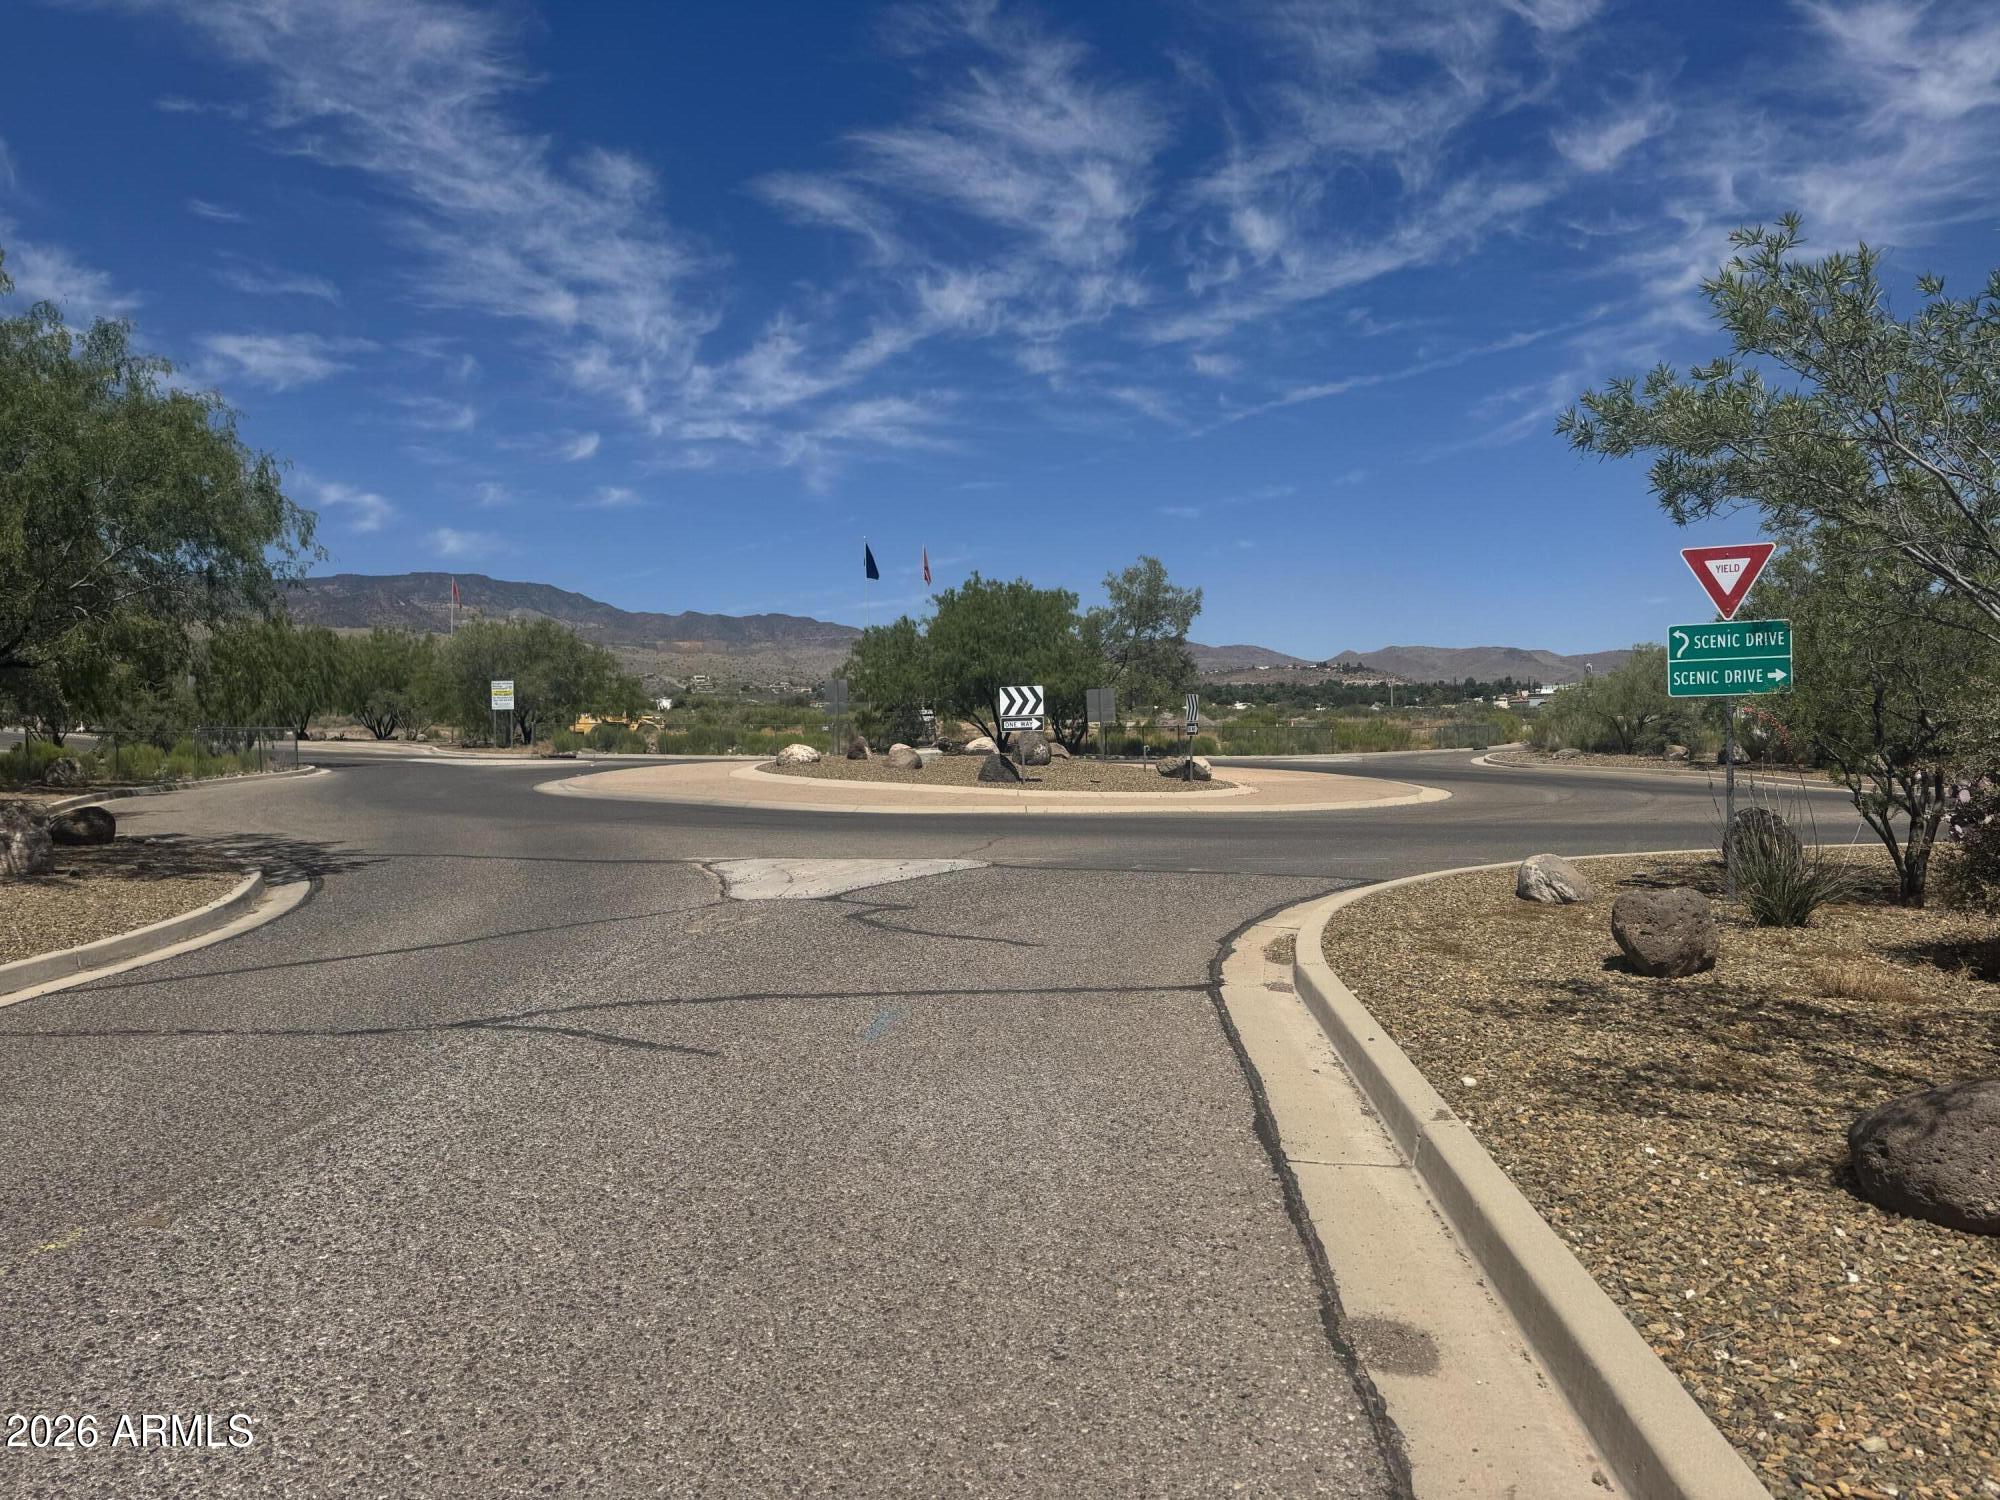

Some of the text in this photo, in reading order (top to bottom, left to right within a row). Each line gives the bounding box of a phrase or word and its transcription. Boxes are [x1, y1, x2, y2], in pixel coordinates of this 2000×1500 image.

[1715, 564, 1740, 573] YIELD
[1694, 632, 1785, 649] SCENIC DRIVE
[1673, 669, 1763, 686] SCENIC DRIVE
